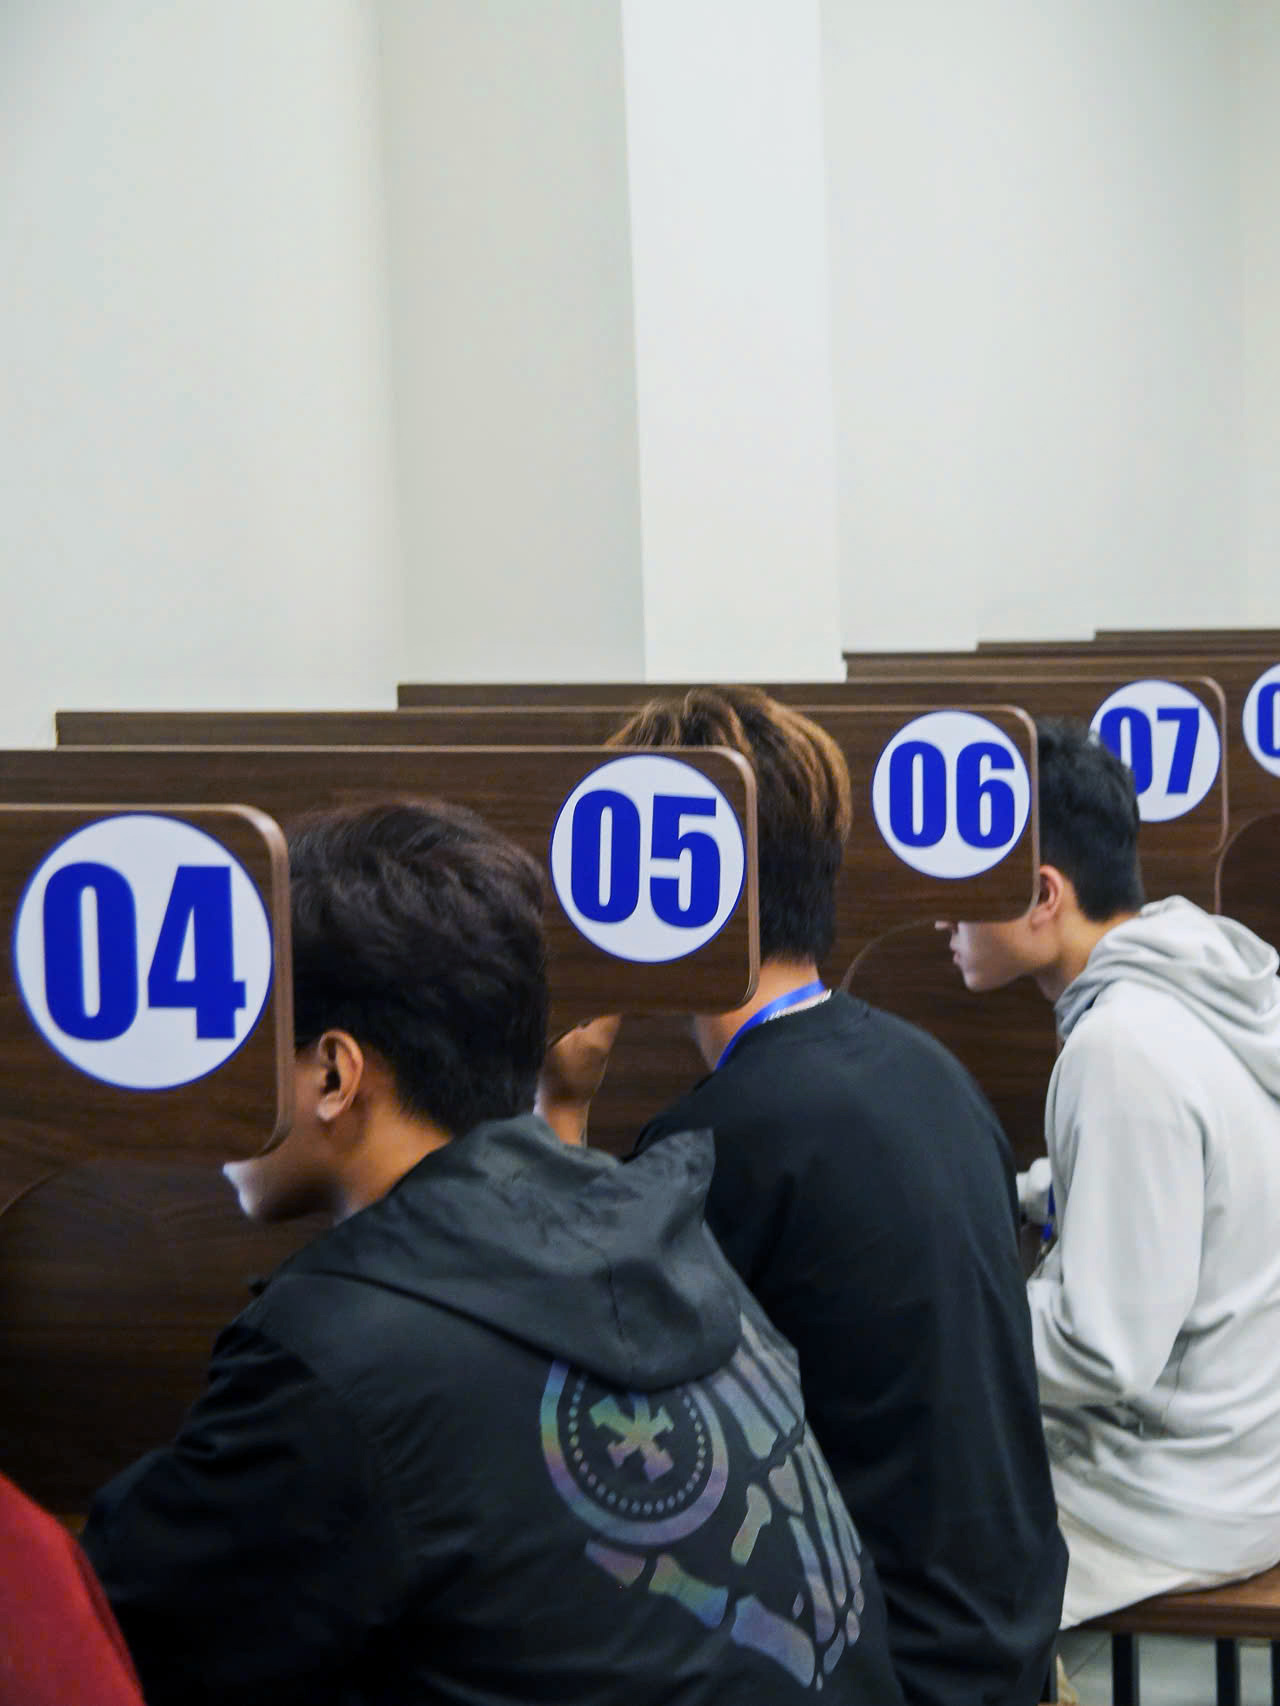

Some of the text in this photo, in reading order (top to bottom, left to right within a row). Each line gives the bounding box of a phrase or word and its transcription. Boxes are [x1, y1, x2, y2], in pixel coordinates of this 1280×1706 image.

[888, 740, 1016, 849] 06
[1099, 706, 1200, 796] 07
[570, 789, 722, 929] 05
[42, 861, 247, 1042] 04
